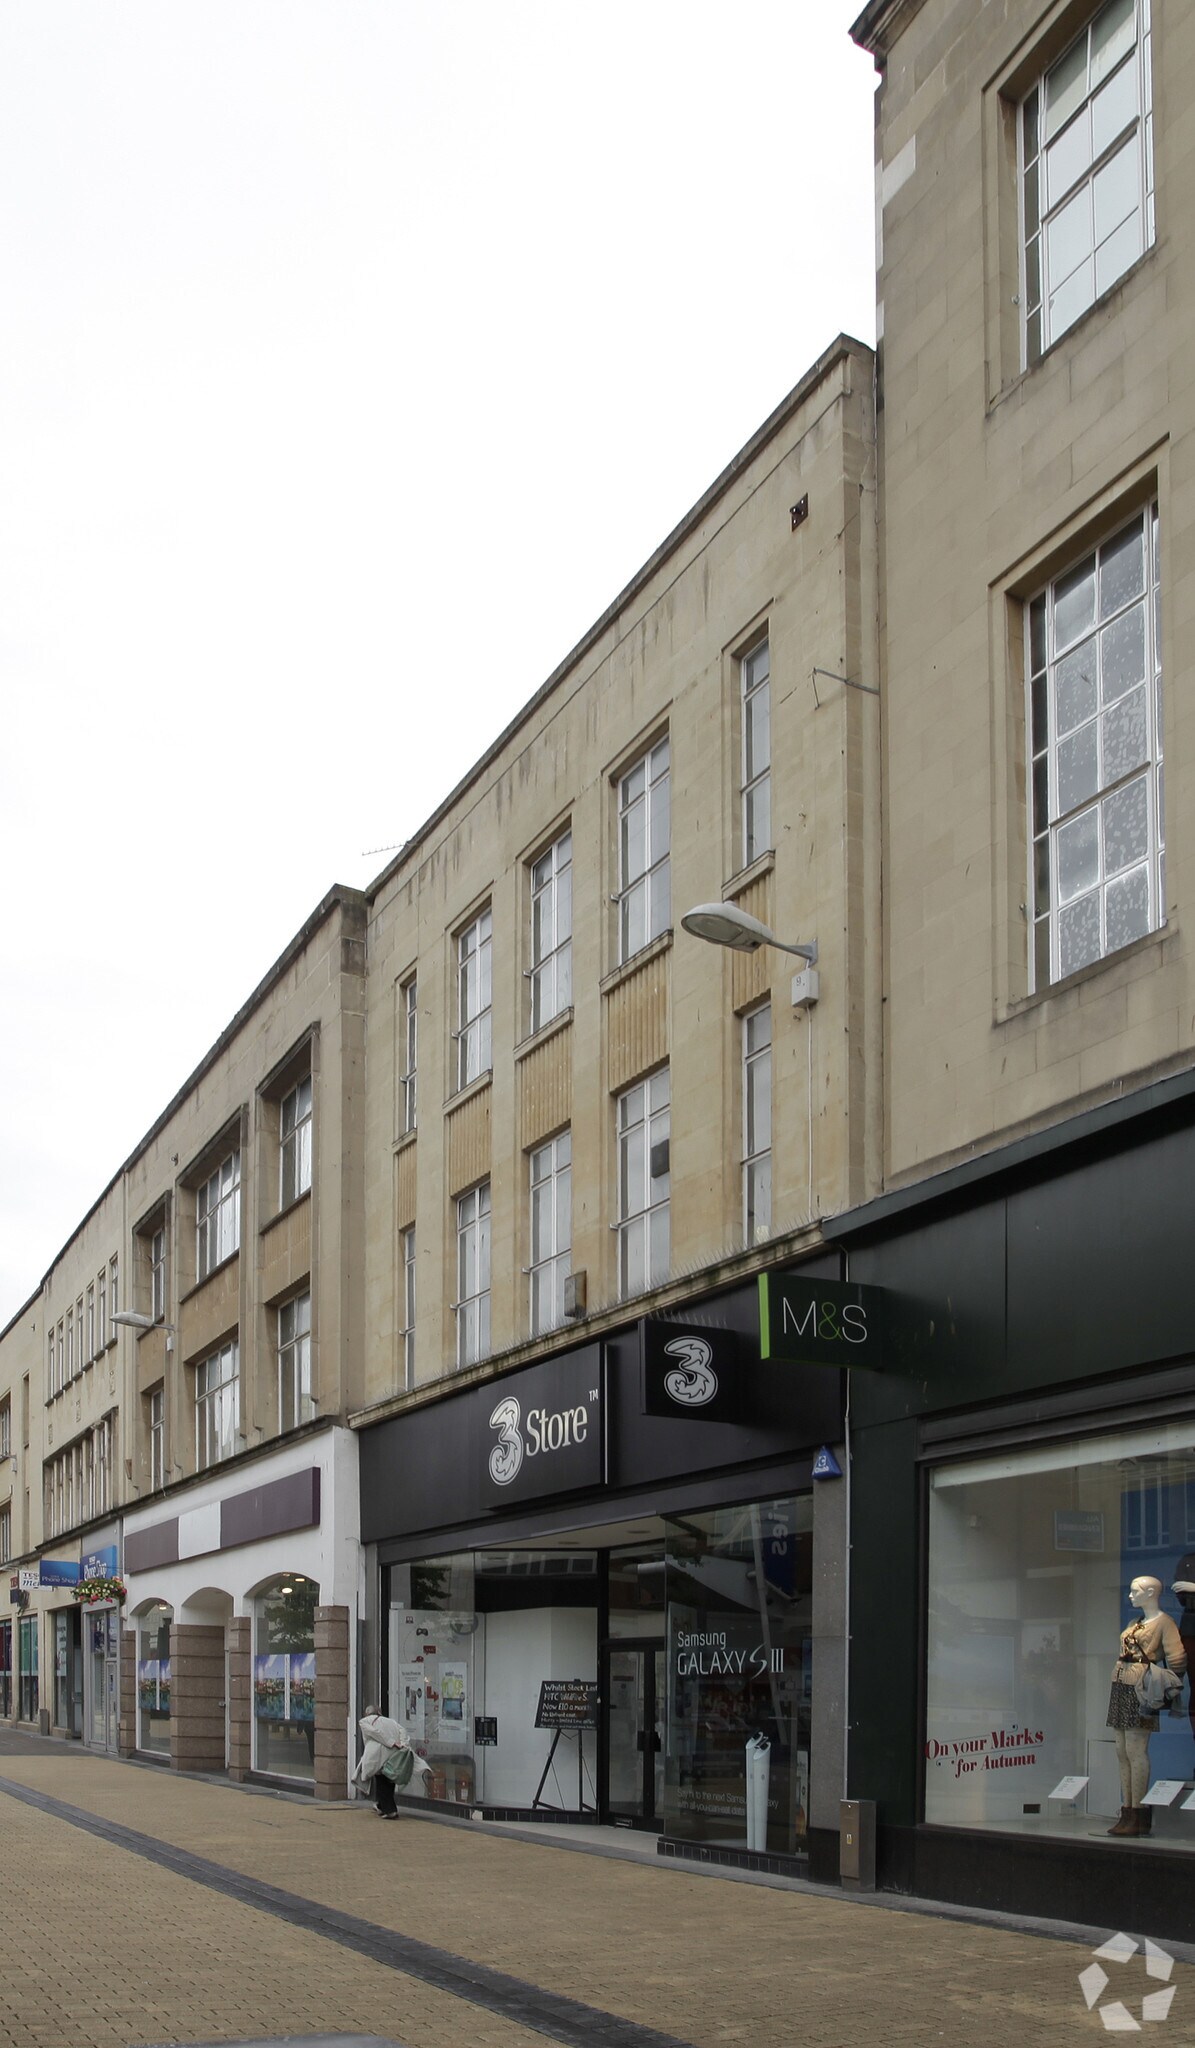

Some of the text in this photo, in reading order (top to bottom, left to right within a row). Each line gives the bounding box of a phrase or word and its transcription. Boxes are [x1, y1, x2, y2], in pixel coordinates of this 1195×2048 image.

[783, 1297, 868, 1343] M&S
[664, 1336, 718, 1406] 3
[489, 1396, 523, 1485] 3
[526, 1406, 588, 1456] Store
[678, 1631, 726, 1650] Samsung
[678, 1650, 746, 1675] GALAXY
[925, 1728, 1044, 1760] On your Marks
[955, 1754, 1036, 1778] for Autumn
